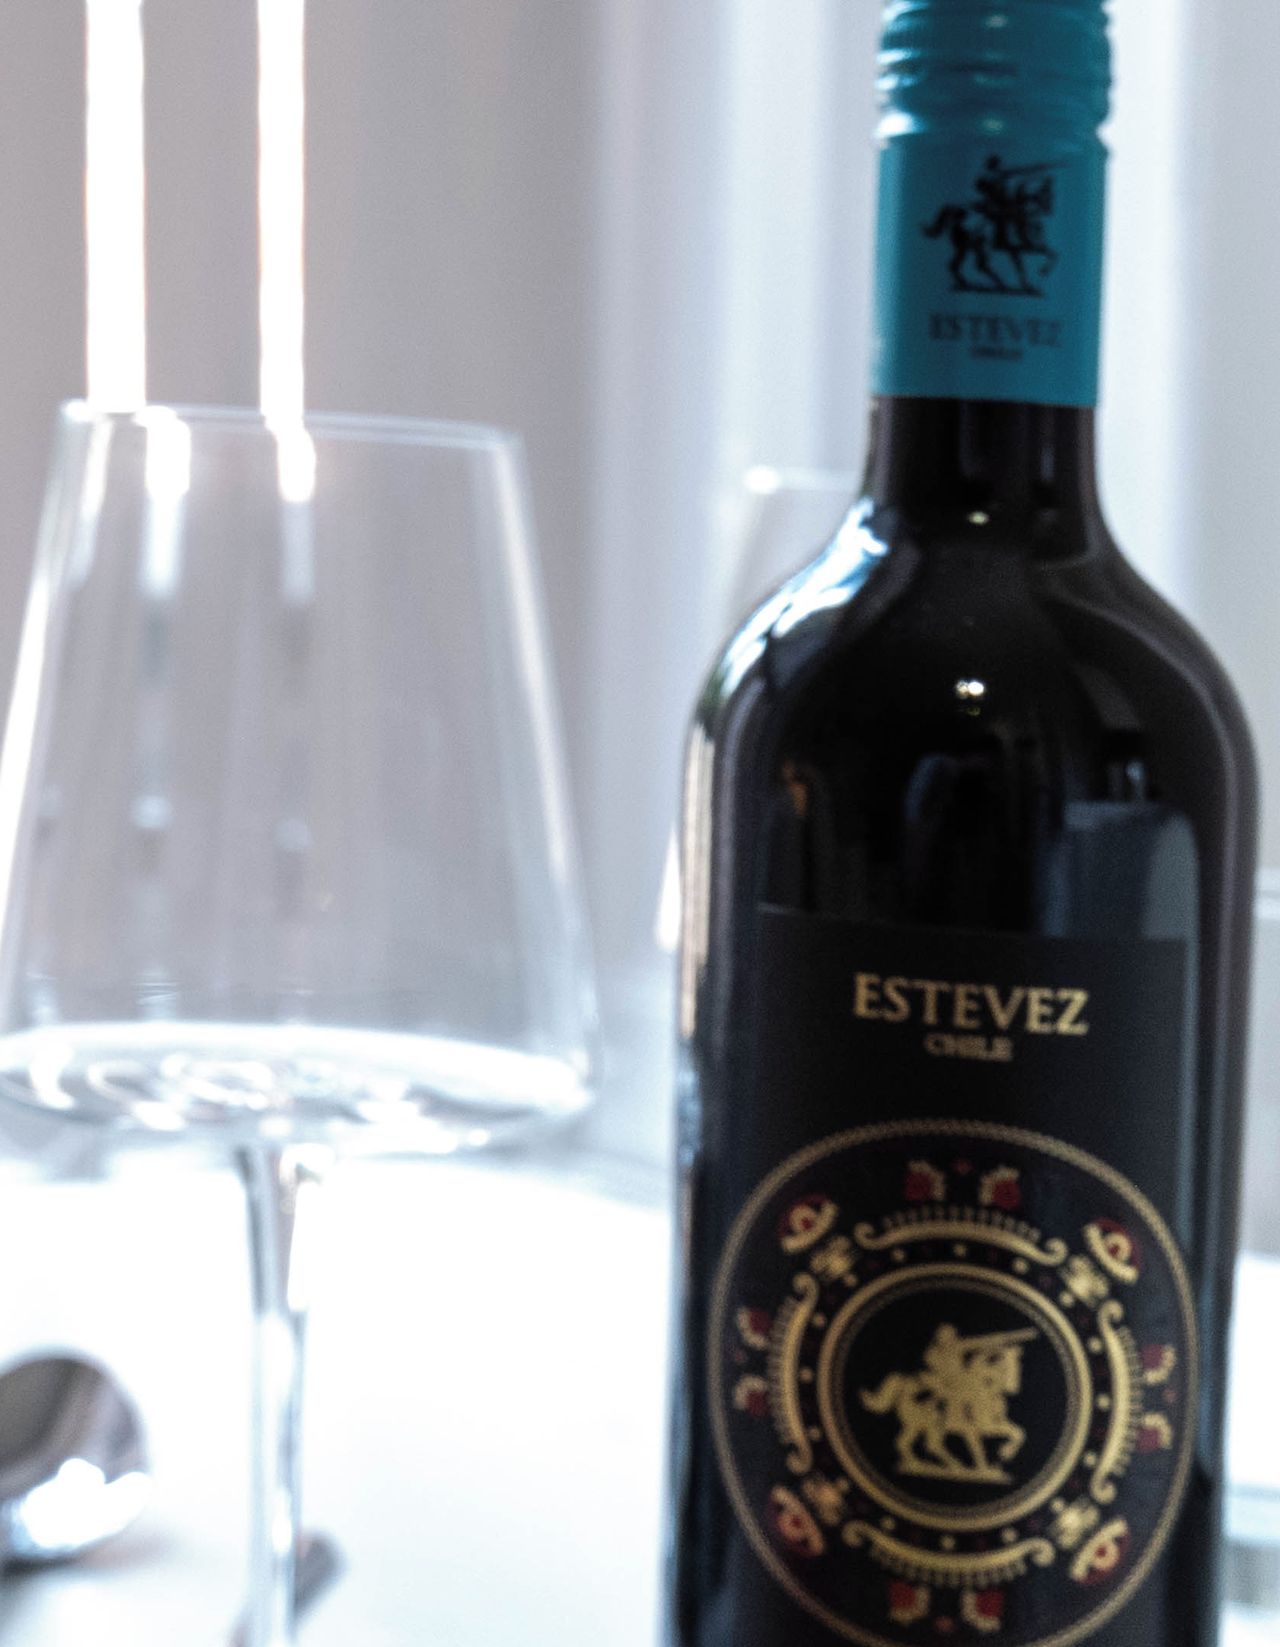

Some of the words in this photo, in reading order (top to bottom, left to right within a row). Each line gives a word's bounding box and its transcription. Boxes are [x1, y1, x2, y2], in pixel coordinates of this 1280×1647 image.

[930, 314, 1063, 347] ESTEVEZ
[854, 972, 1088, 1035] ESTEVEZ
[924, 1034, 1013, 1061] CHILE
